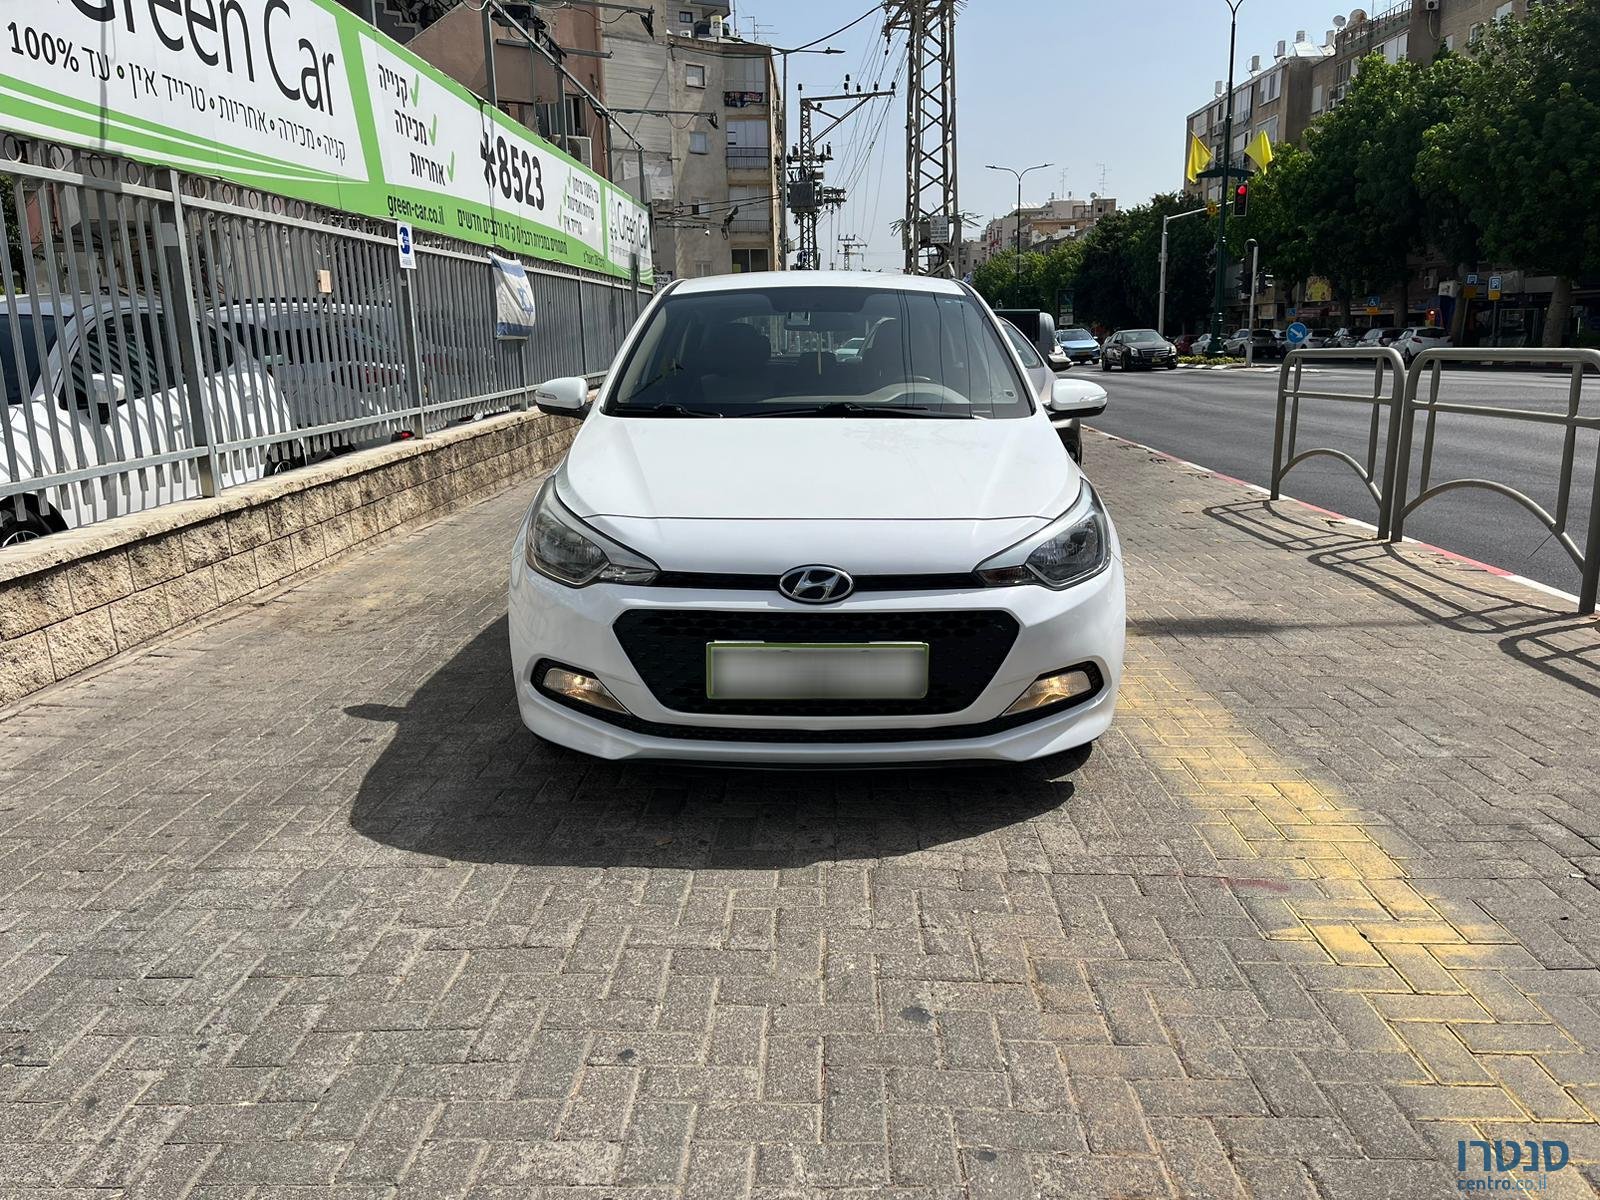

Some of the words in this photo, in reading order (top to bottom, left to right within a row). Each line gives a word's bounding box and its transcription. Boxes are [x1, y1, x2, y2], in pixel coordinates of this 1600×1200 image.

[7, 21, 80, 73] 100%
[71, 0, 254, 83] een
[264, 0, 335, 117] Car
[81, 46, 111, 82] עד
[128, 62, 158, 99] אין
[161, 73, 206, 112] טרייד
[377, 63, 407, 108] קנייה
[218, 94, 268, 134] אחריות
[394, 109, 428, 146] מכירה
[278, 117, 315, 150] מכירה
[323, 134, 346, 166] קניה
[410, 152, 446, 186] אחריות
[387, 194, 445, 225] green-car.co.il
[457, 208, 482, 232] חדשים
